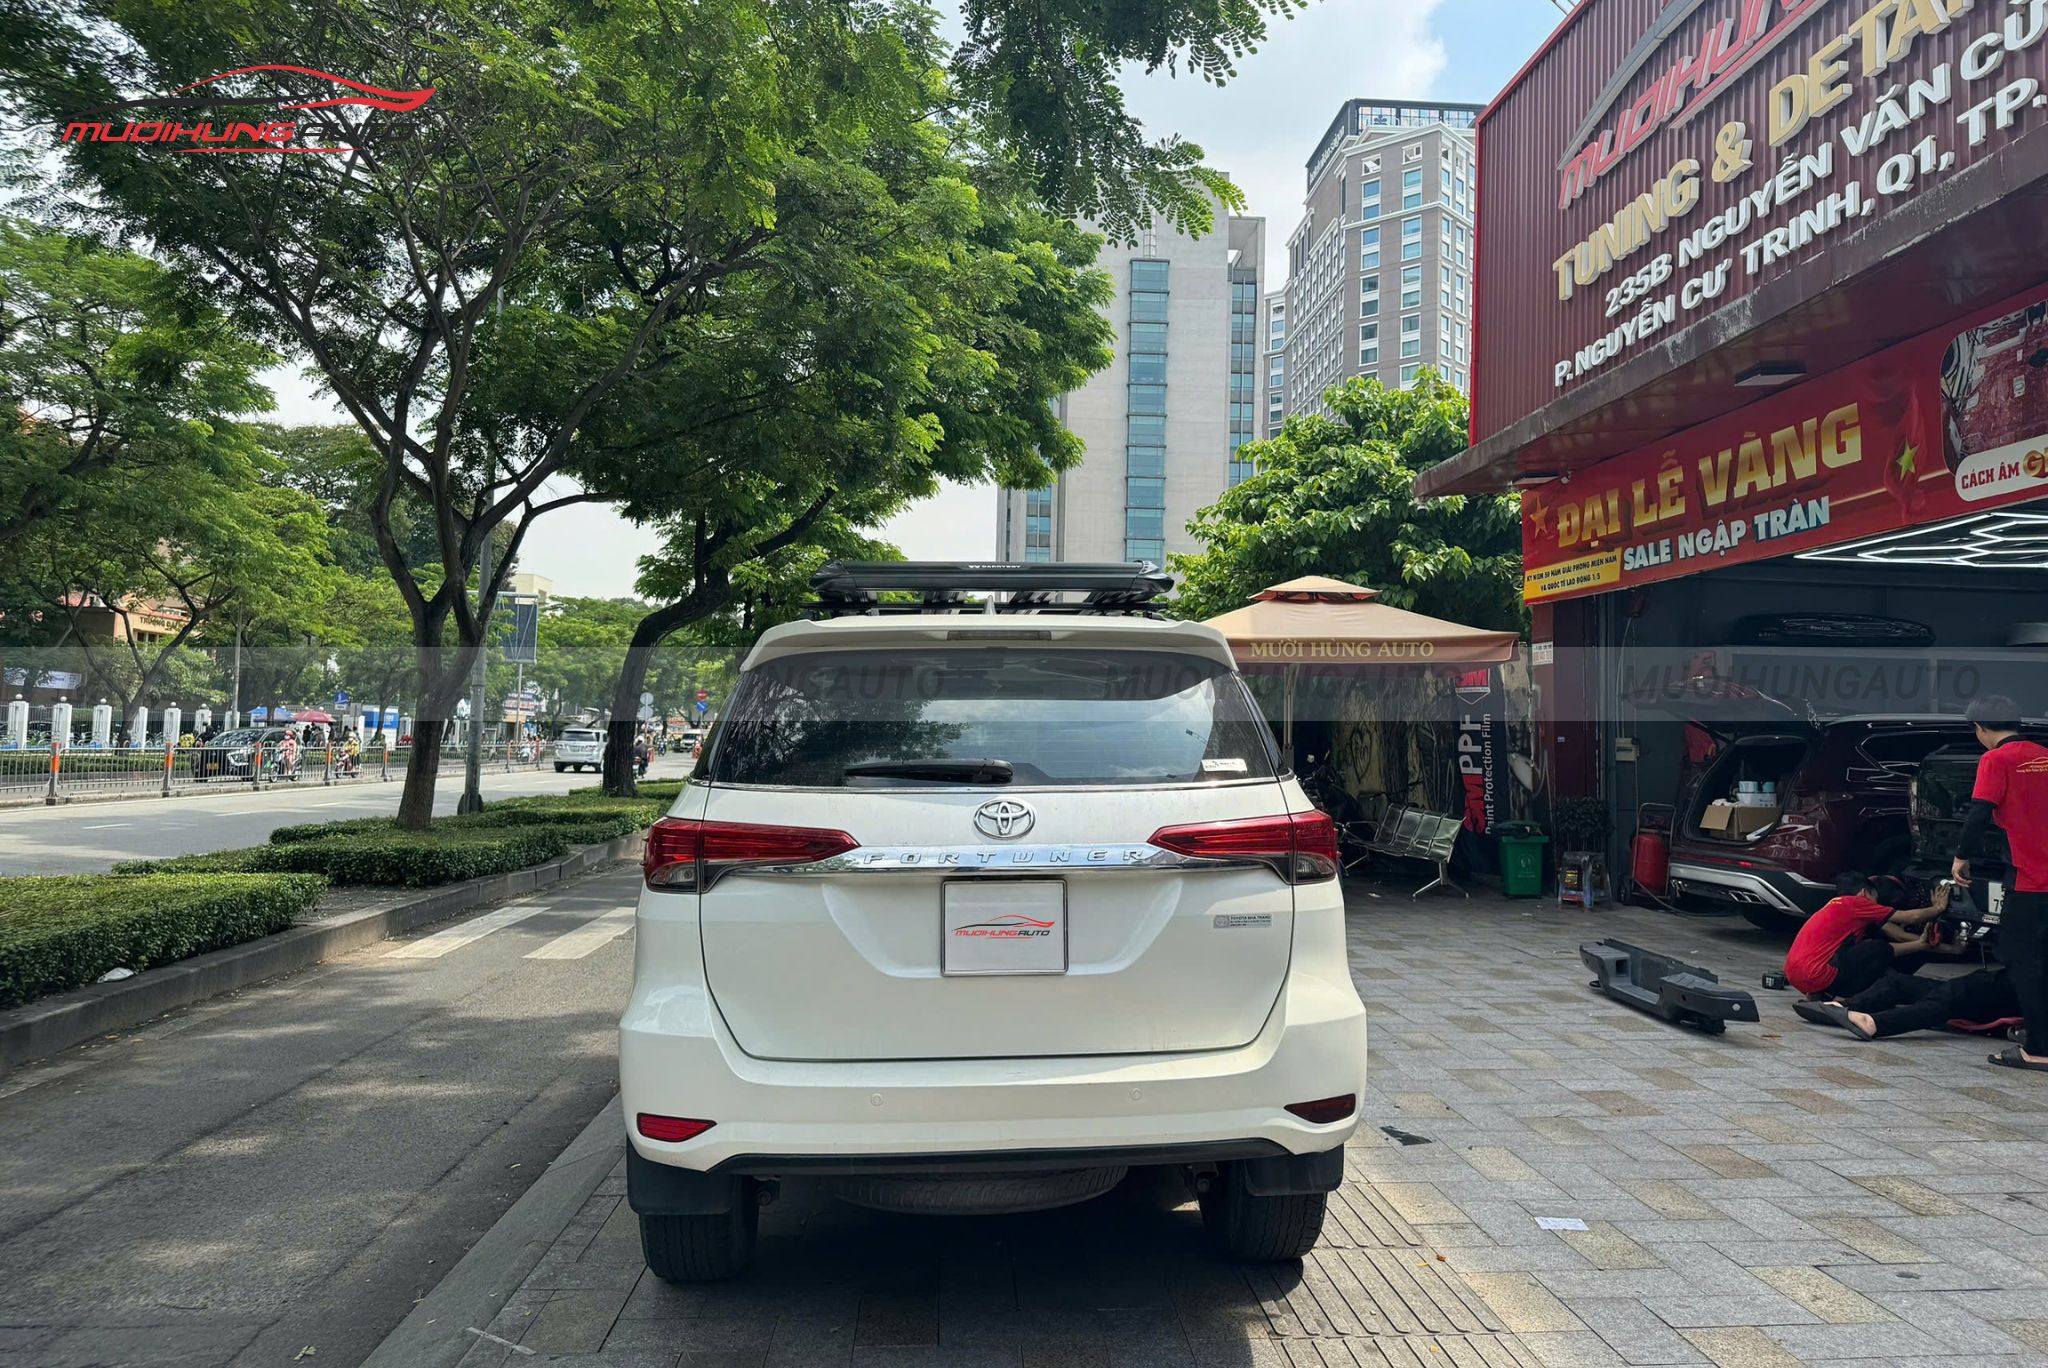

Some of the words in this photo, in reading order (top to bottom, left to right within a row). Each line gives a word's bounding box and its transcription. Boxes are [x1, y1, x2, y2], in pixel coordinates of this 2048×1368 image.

[1553, 158, 1700, 301] TUNING
[1712, 121, 1754, 183] &
[1769, 0, 1976, 147] DETA
[1740, 180, 1875, 275] TRINH,
[1876, 135, 1956, 195] Q1,
[1956, 78, 2048, 148] TP.
[1605, 252, 1673, 318] 235B
[1678, 142, 1833, 268] NGUYỄN
[1840, 63, 1952, 157] VĂN
[1557, 488, 1622, 548] ĐẠI
[1632, 449, 1686, 528] LỄ
[1698, 402, 1863, 507] VÀNG
[1961, 467, 1995, 490] CÁCH
[1998, 460, 2020, 481] ÂM
[1623, 538, 1672, 571] SALE
[1678, 518, 1747, 560] NGẬP
[1754, 495, 1831, 542] TRÀN
[1250, 638, 1304, 658] MƯỜI
[1310, 637, 1371, 658] HÙNG
[1377, 641, 1435, 658] AUTO
[1457, 712, 1484, 775] PPF
[1481, 712, 1492, 738] Film
[1481, 740, 1495, 802] Protection
[863, 847, 1145, 866] FORTUNER
